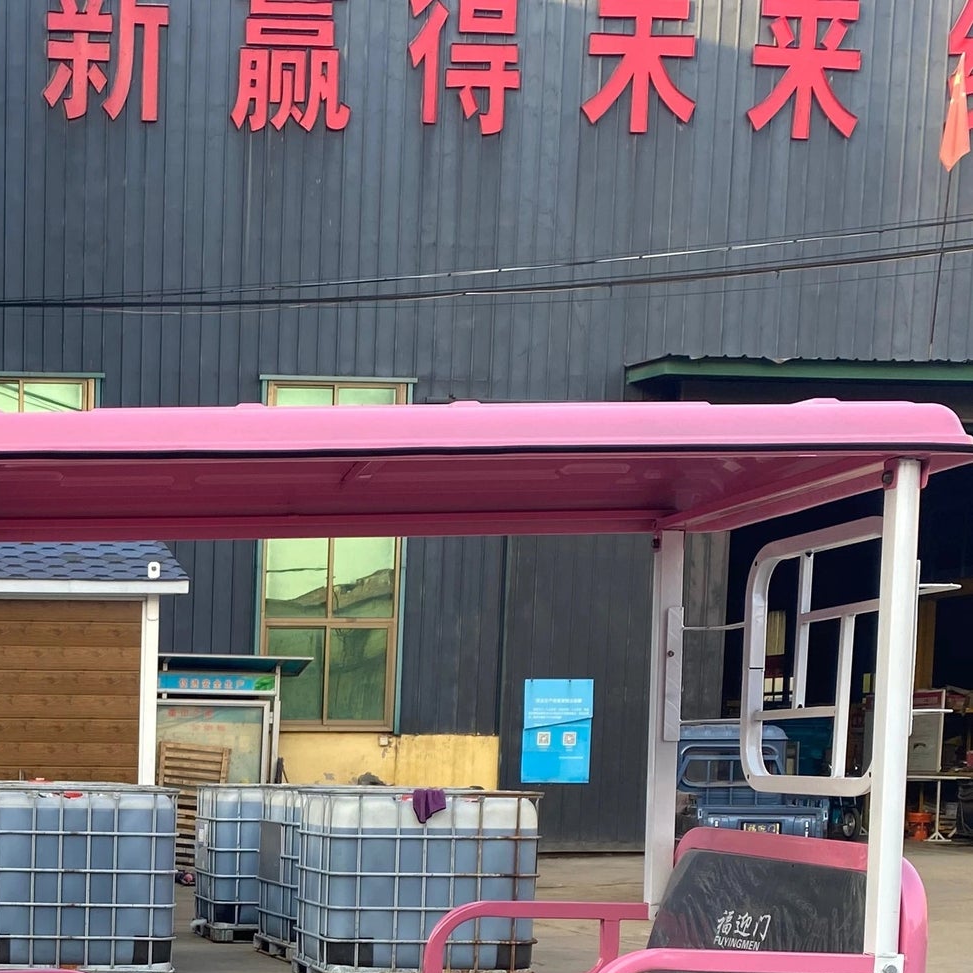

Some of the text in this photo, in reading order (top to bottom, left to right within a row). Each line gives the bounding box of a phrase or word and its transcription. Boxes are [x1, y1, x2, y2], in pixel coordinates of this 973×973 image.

[716, 910, 772, 941] 福迎门
[713, 935, 761, 951] FUYINGMEN
